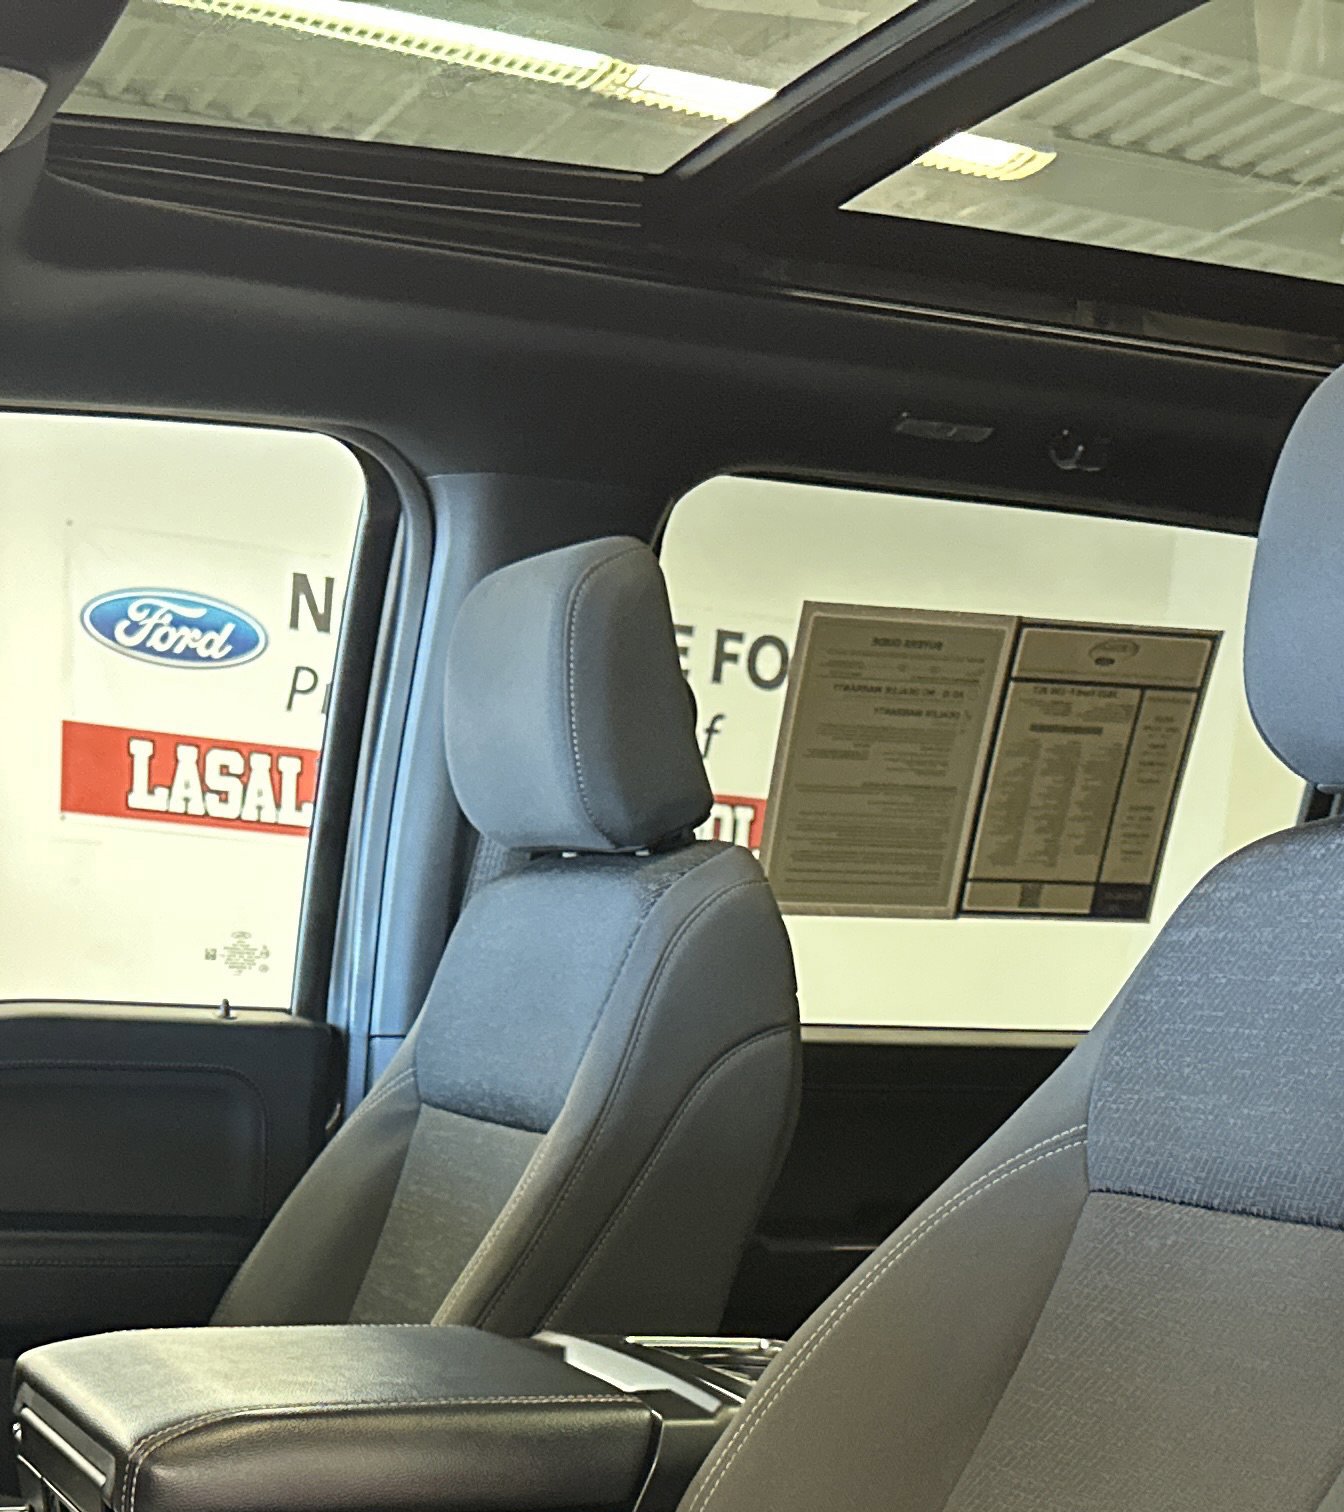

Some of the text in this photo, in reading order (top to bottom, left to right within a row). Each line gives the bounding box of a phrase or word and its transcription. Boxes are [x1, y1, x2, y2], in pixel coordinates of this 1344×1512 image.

[114, 598, 233, 659] Ford
[711, 629, 789, 690] FO
[127, 737, 313, 827] LASAL
